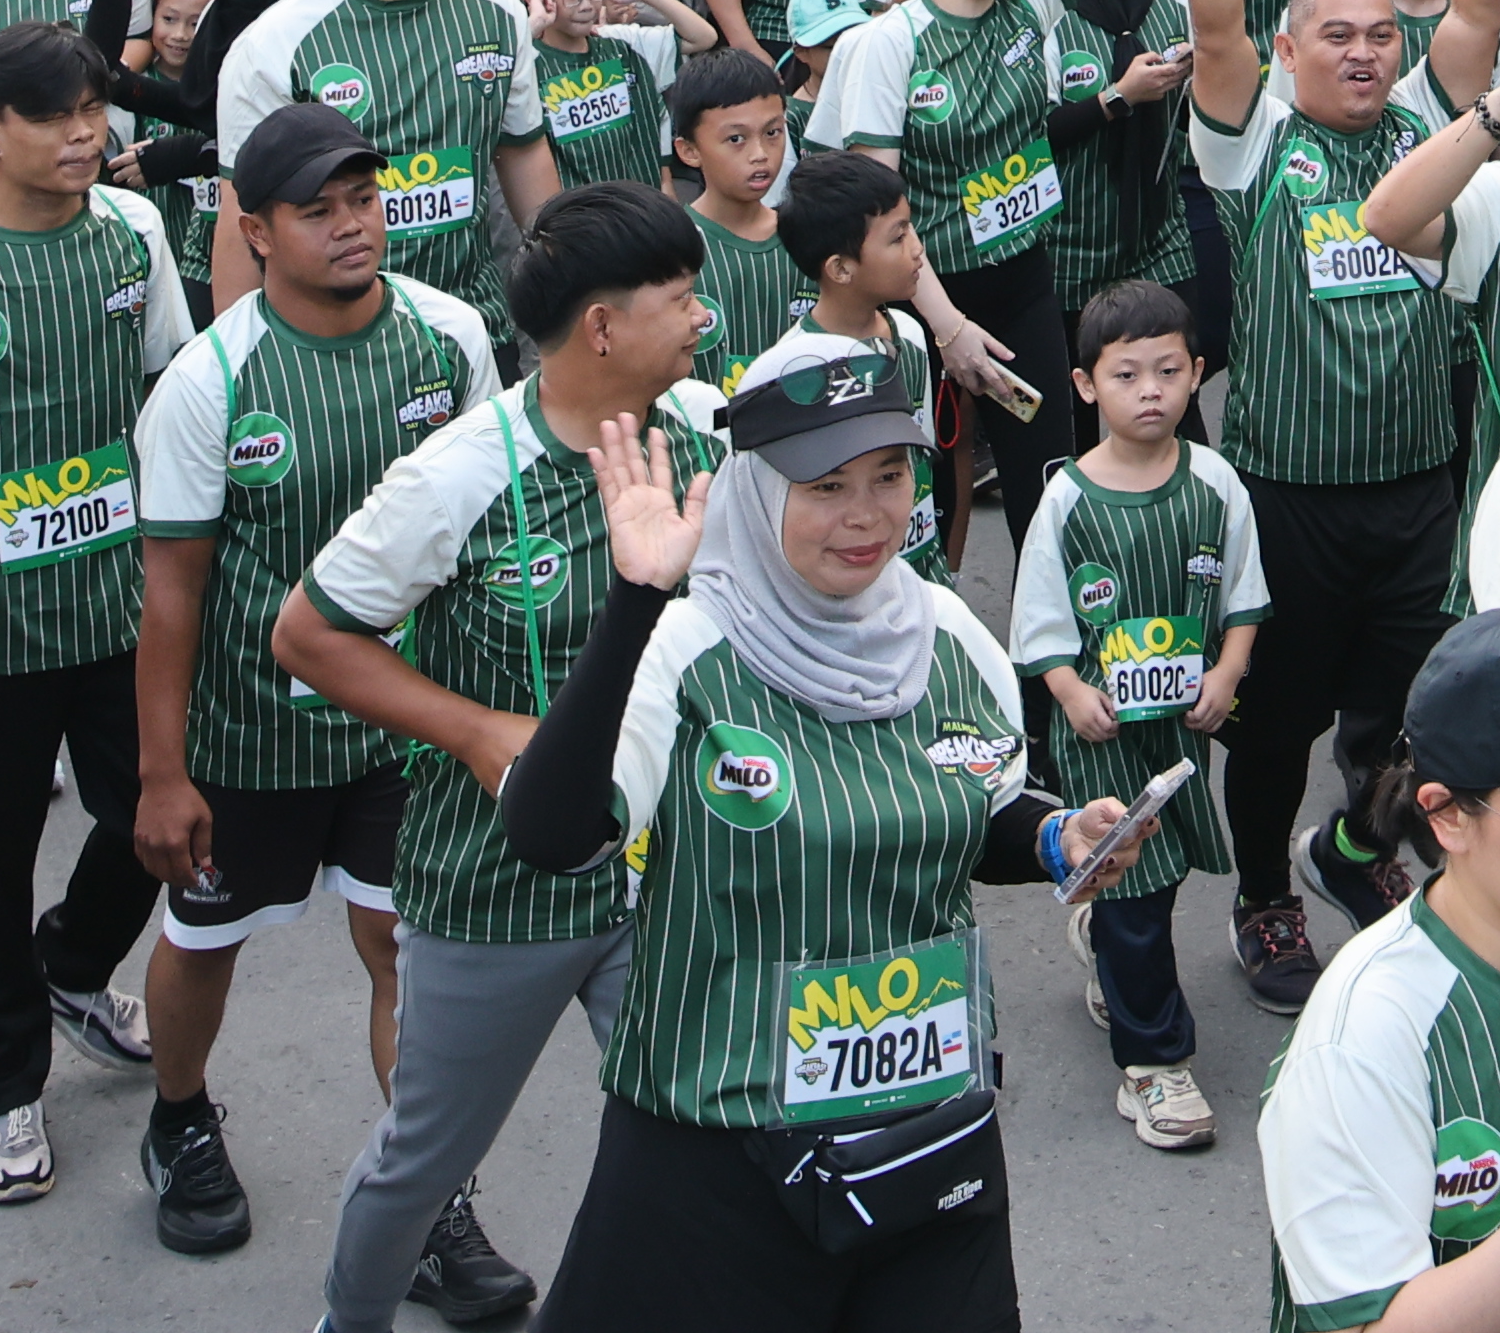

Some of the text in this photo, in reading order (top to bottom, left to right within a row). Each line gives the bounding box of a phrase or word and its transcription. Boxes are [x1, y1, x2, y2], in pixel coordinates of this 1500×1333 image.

[454, 52, 515, 76] BREAKFAST
[468, 44, 500, 53] MALAYSIA
[543, 66, 603, 112] MILO
[1065, 70, 1095, 84] MILO
[325, 88, 360, 102] MILO
[570, 84, 621, 128] 6255C
[914, 90, 945, 103] MILO
[962, 154, 1027, 217] MILO
[384, 189, 453, 227] 6013A
[995, 184, 1041, 230] 3227
[405, 421, 419, 431] DAY
[233, 441, 280, 463] MILO
[31, 497, 110, 550] 7210D
[1082, 584, 1114, 605] MILO
[1099, 617, 1174, 677] MILO
[1117, 664, 1186, 705] 6002C
[926, 734, 1017, 766] BREAKFAST
[718, 760, 773, 787] MILO
[787, 957, 919, 1052] MILO
[827, 1021, 943, 1093] 7082A
[1435, 1164, 1498, 1198] MILO
